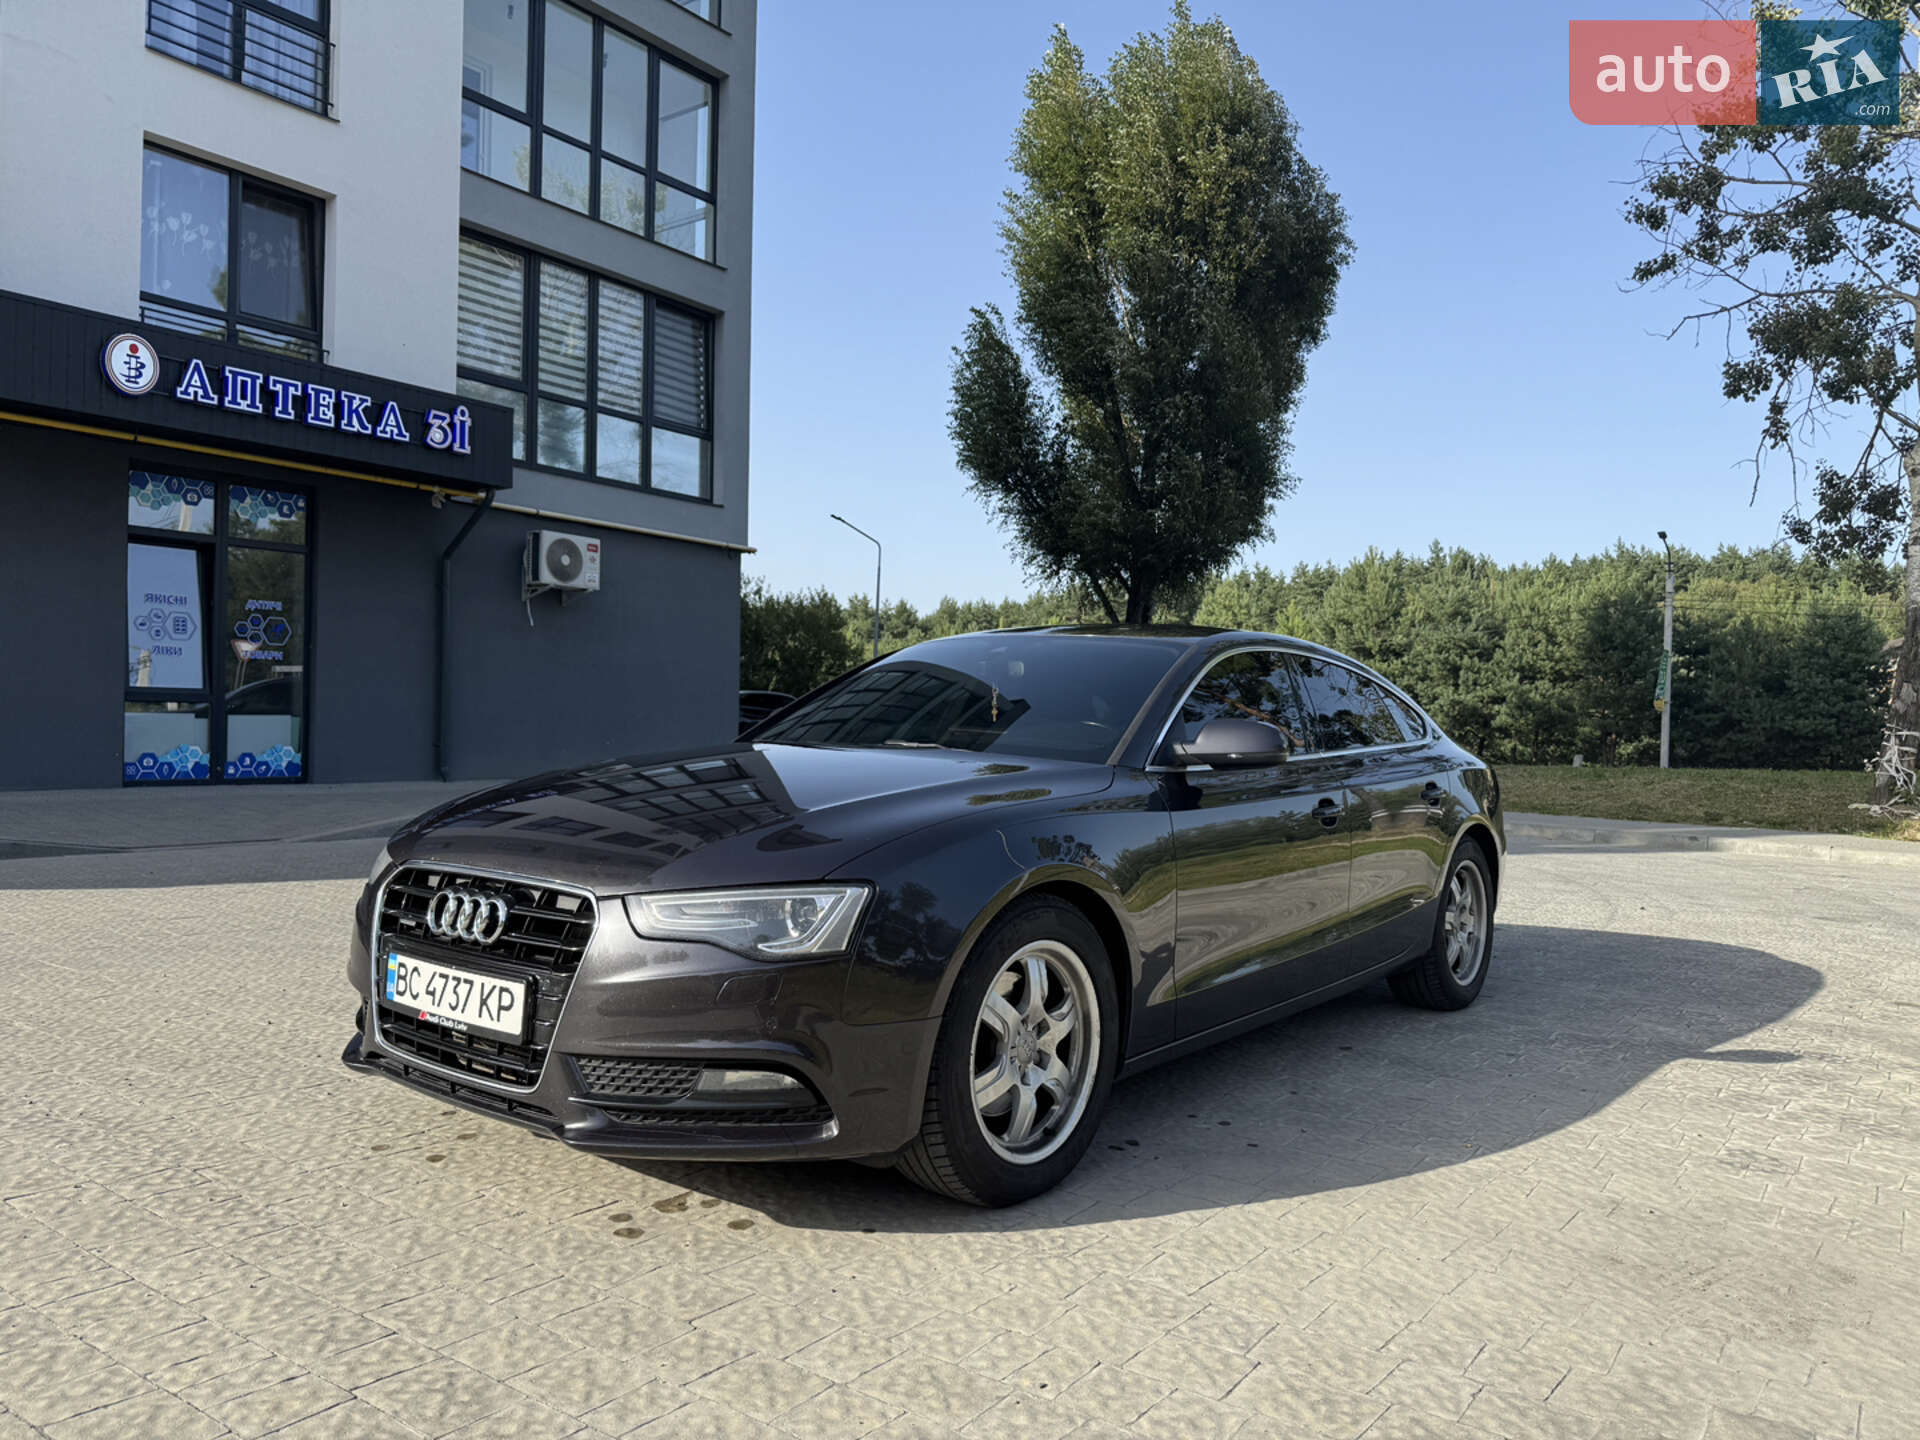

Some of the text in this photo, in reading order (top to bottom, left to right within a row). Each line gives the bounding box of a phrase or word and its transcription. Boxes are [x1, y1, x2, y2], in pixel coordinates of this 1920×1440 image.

[177, 358, 409, 443] АПТЕКА
[144, 592, 188, 605] ЯКІСНІ
[152, 645, 183, 656] ЛІКИ
[395, 962, 515, 1022] BC 4737 KP
